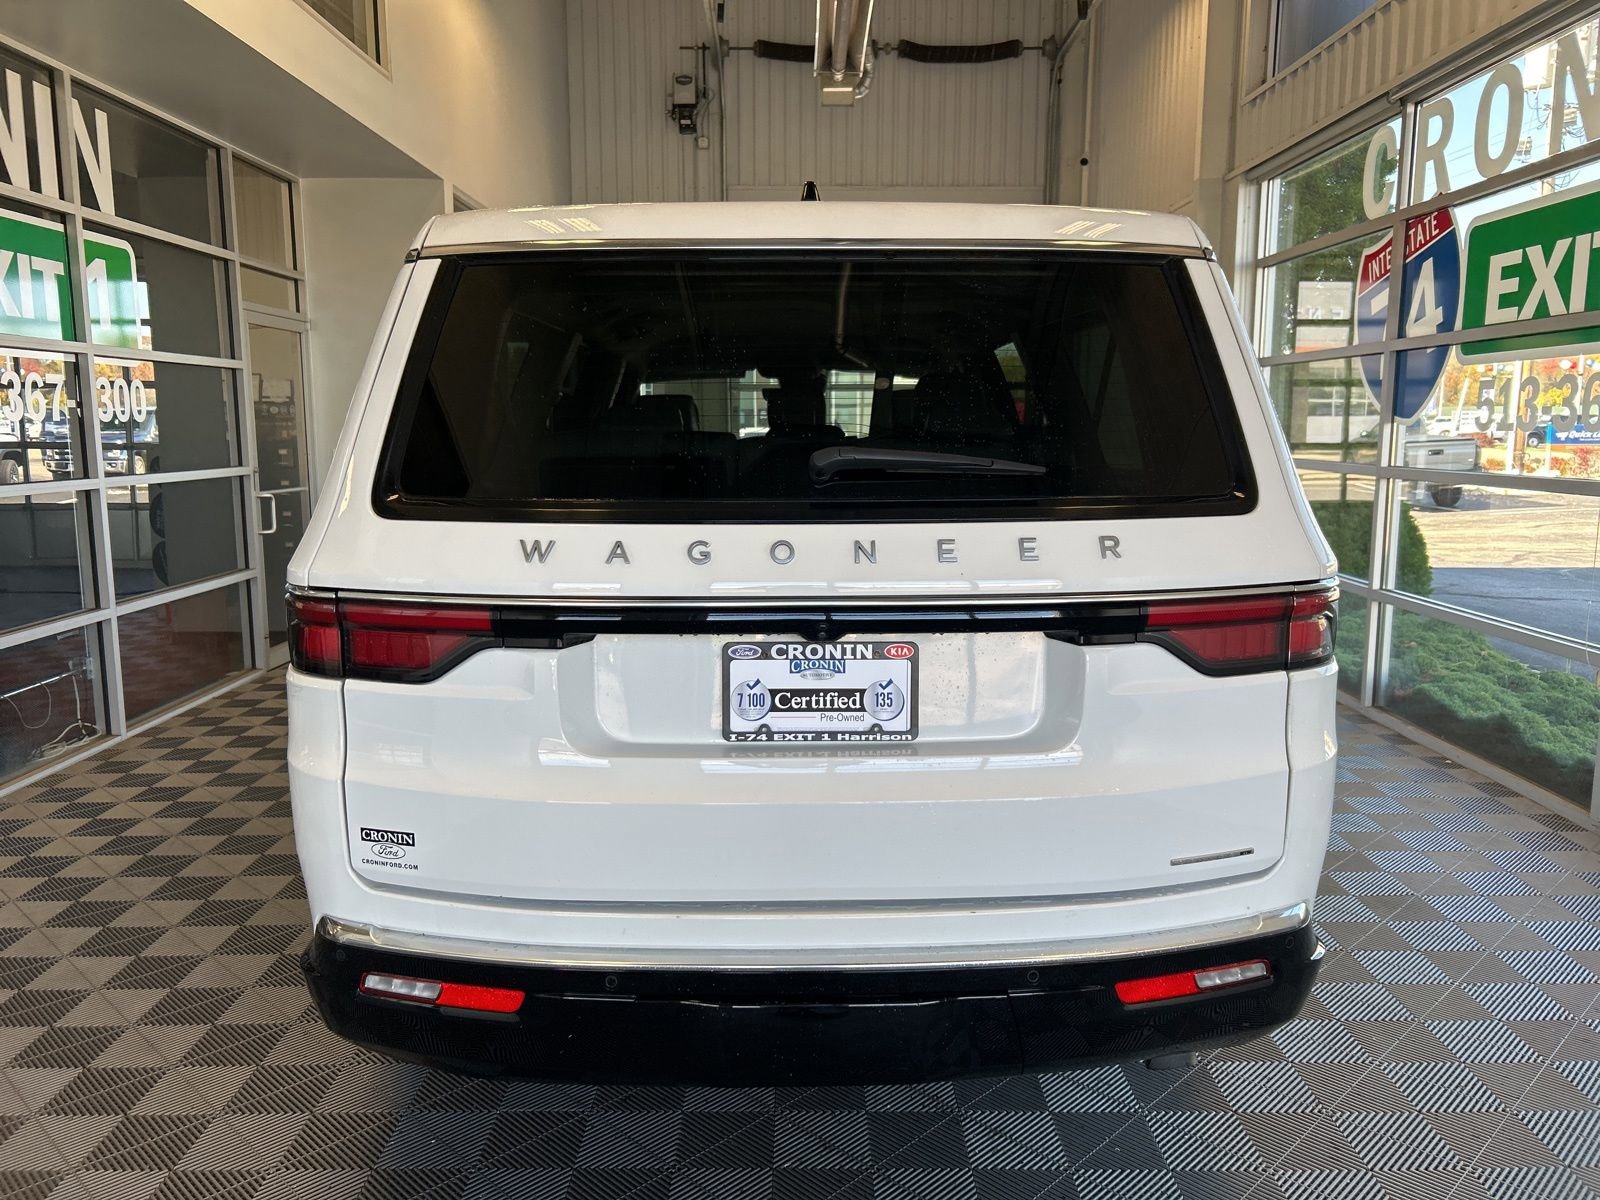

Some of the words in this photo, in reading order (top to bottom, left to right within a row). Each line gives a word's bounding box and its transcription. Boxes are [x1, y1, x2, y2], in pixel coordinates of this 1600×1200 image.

[1368, 212, 1439, 284] INTETATE
[1485, 233, 1600, 325] EXI
[519, 535, 1122, 566] WAGONEER
[735, 647, 755, 656] Ford
[770, 643, 873, 660] CRONIN
[890, 647, 909, 656] KIA
[791, 659, 845, 673] CRONIN
[737, 693, 744, 708] 7
[747, 693, 765, 708] 100
[775, 692, 862, 709] Certified
[875, 692, 893, 708] 135
[820, 713, 865, 722] Pre-Owned
[362, 829, 413, 845] CRONIN
[378, 845, 399, 857] Ford
[361, 858, 419, 870] CRONINFORD.COM
